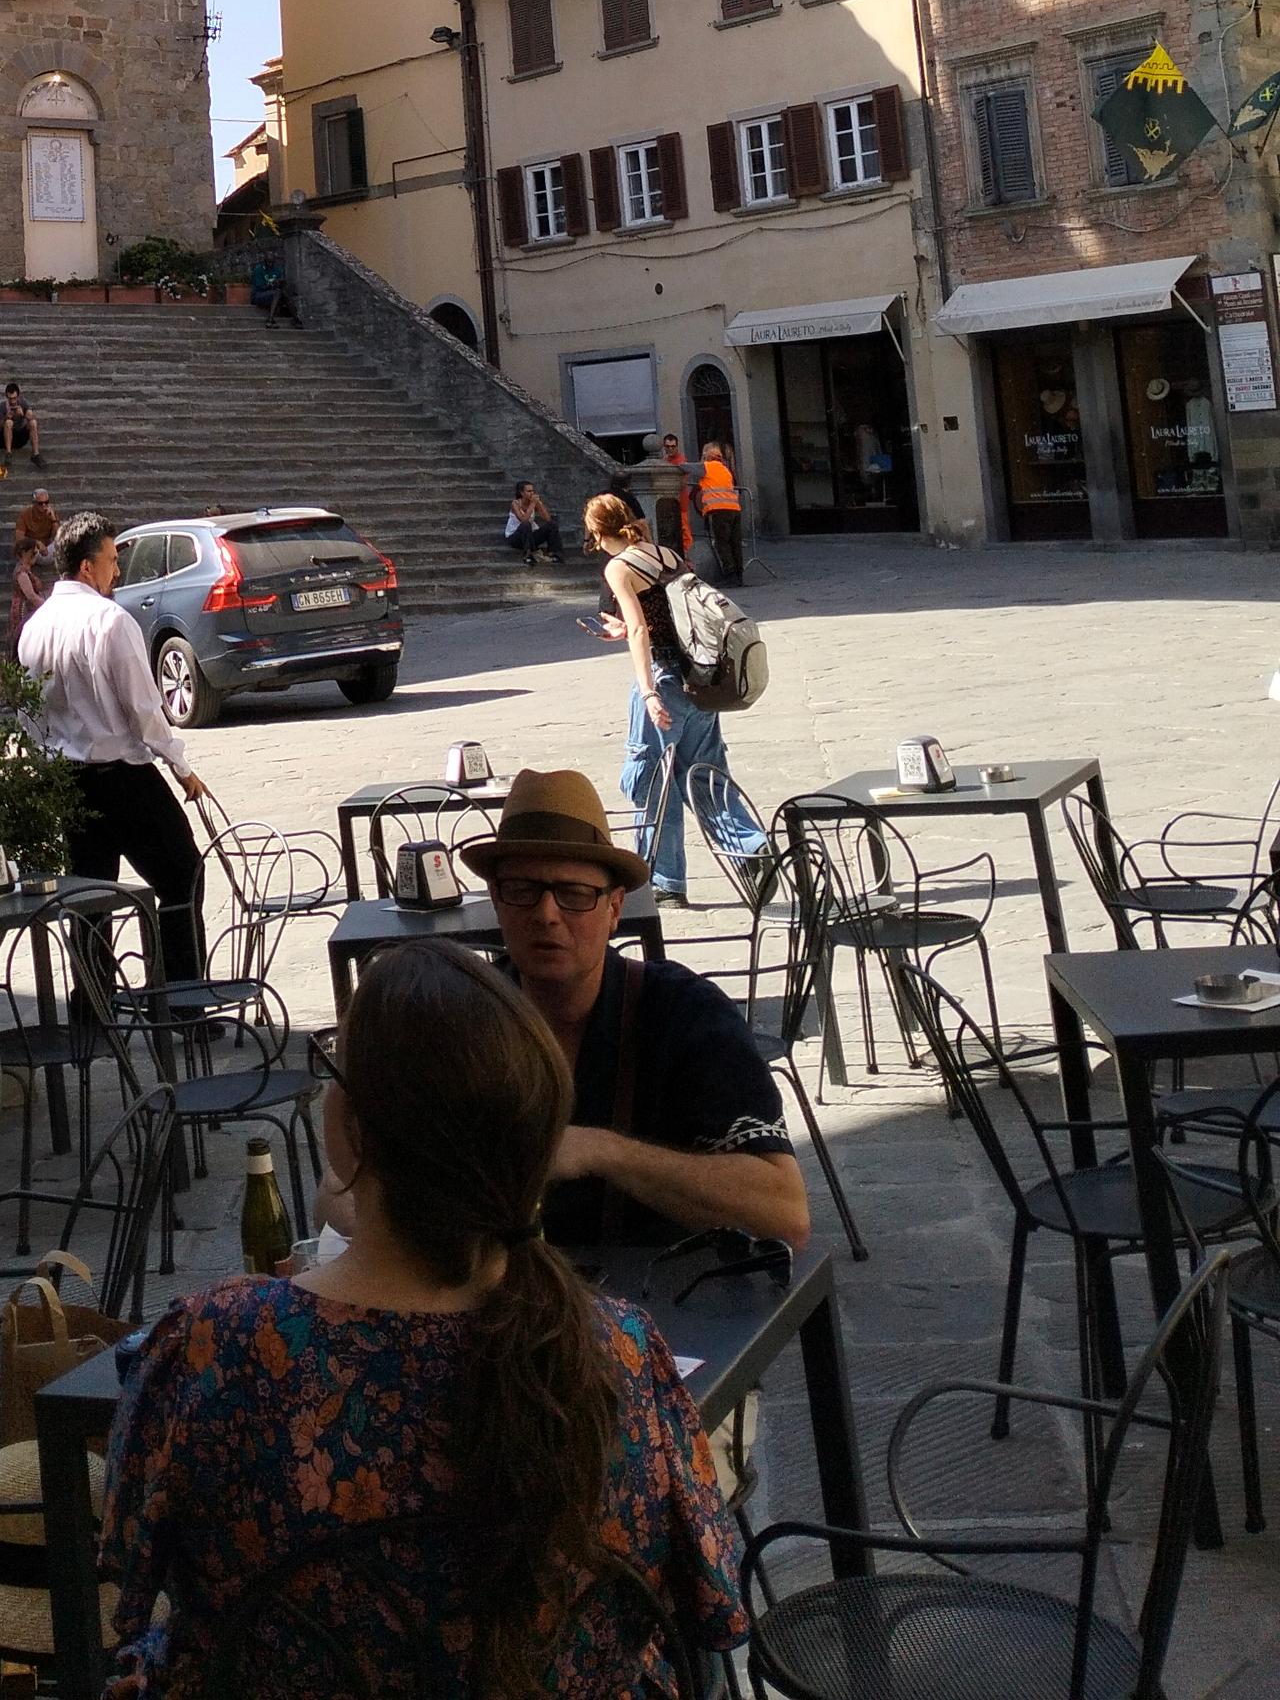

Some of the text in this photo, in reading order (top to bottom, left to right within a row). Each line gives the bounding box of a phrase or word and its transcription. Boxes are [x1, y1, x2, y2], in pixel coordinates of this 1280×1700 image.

[750, 328, 777, 343] LAURA
[777, 324, 816, 341] LAURETO
[1024, 432, 1079, 447] LAURA LAURETO
[1150, 424, 1211, 439] LAURA LAURETO
[312, 587, 344, 604] 865EH
